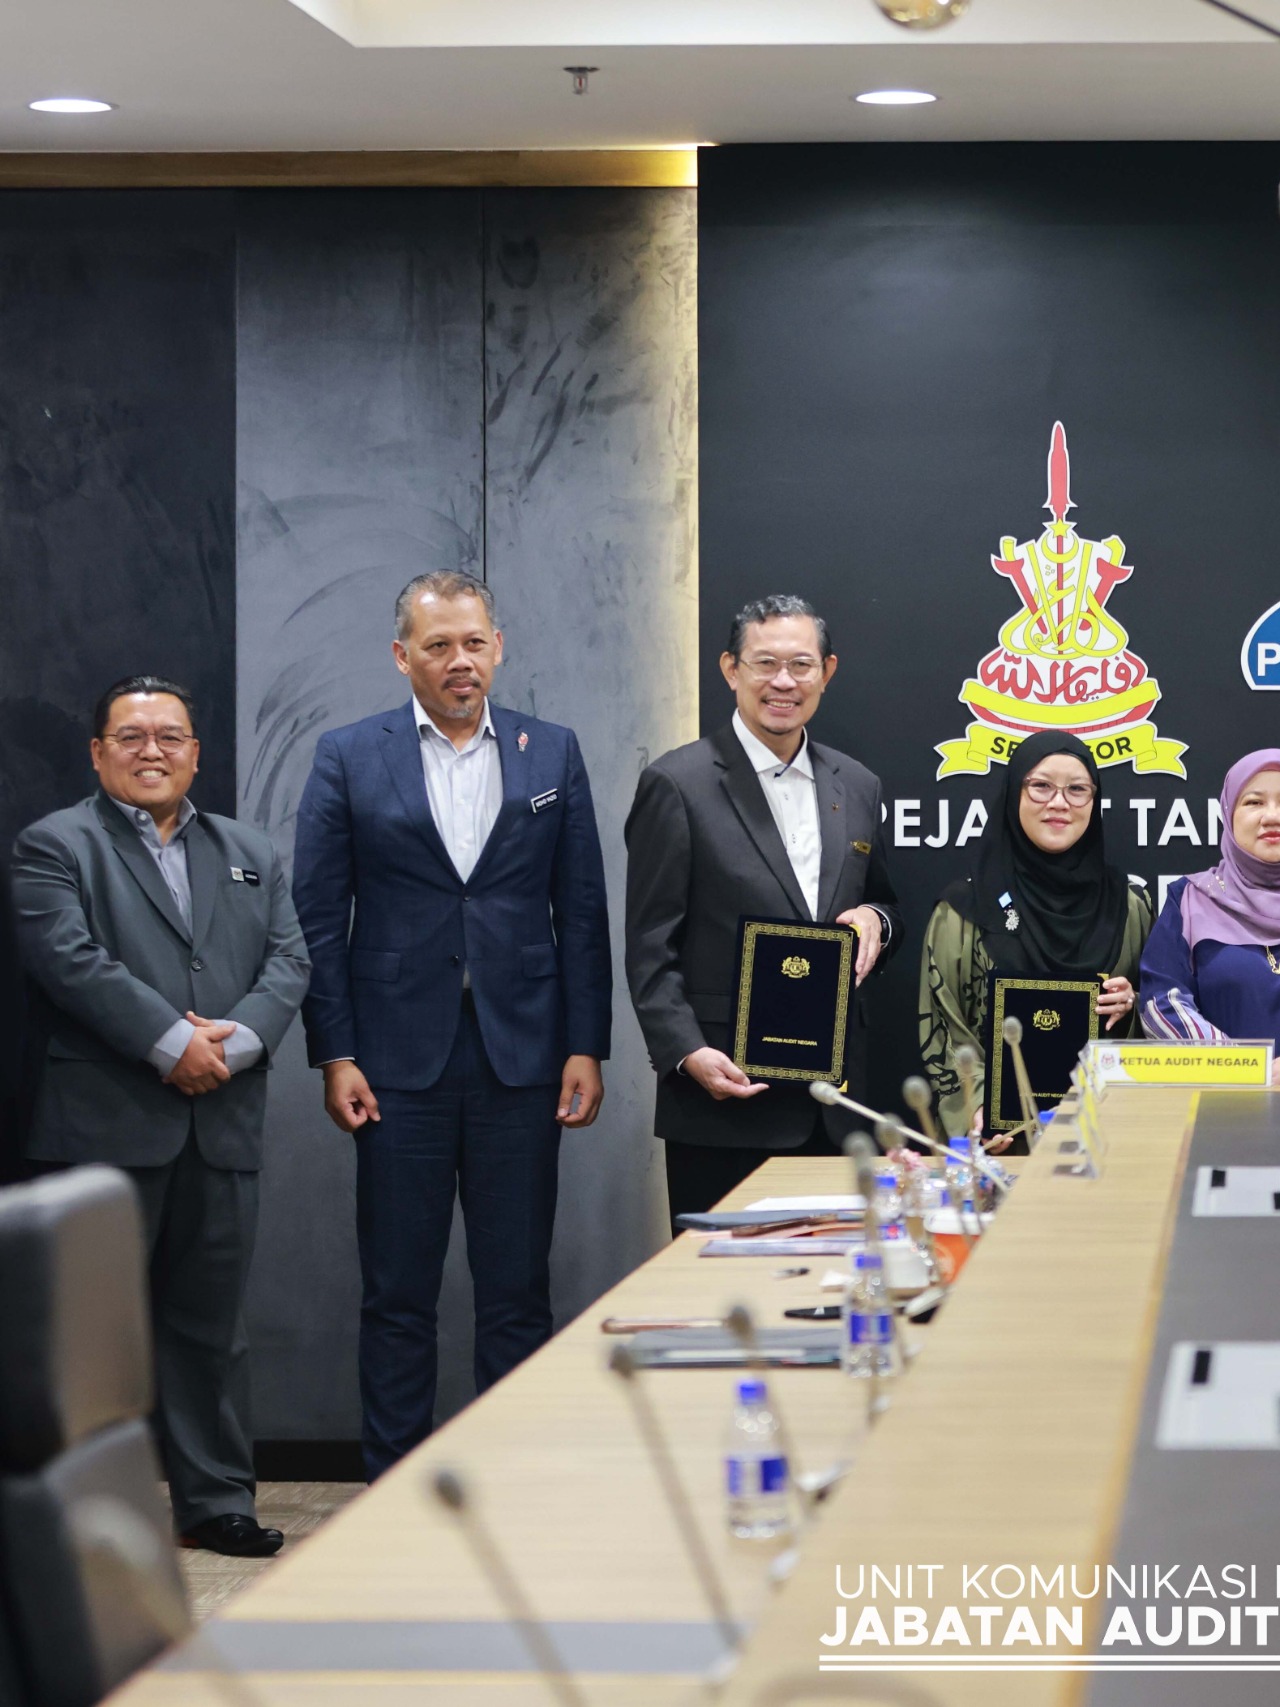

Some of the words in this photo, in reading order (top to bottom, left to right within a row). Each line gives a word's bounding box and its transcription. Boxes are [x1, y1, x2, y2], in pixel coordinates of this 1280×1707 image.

[1119, 1056, 1161, 1066] KETUA
[1164, 1057, 1203, 1067] AUDIT
[1206, 1057, 1259, 1067] NEGARA
